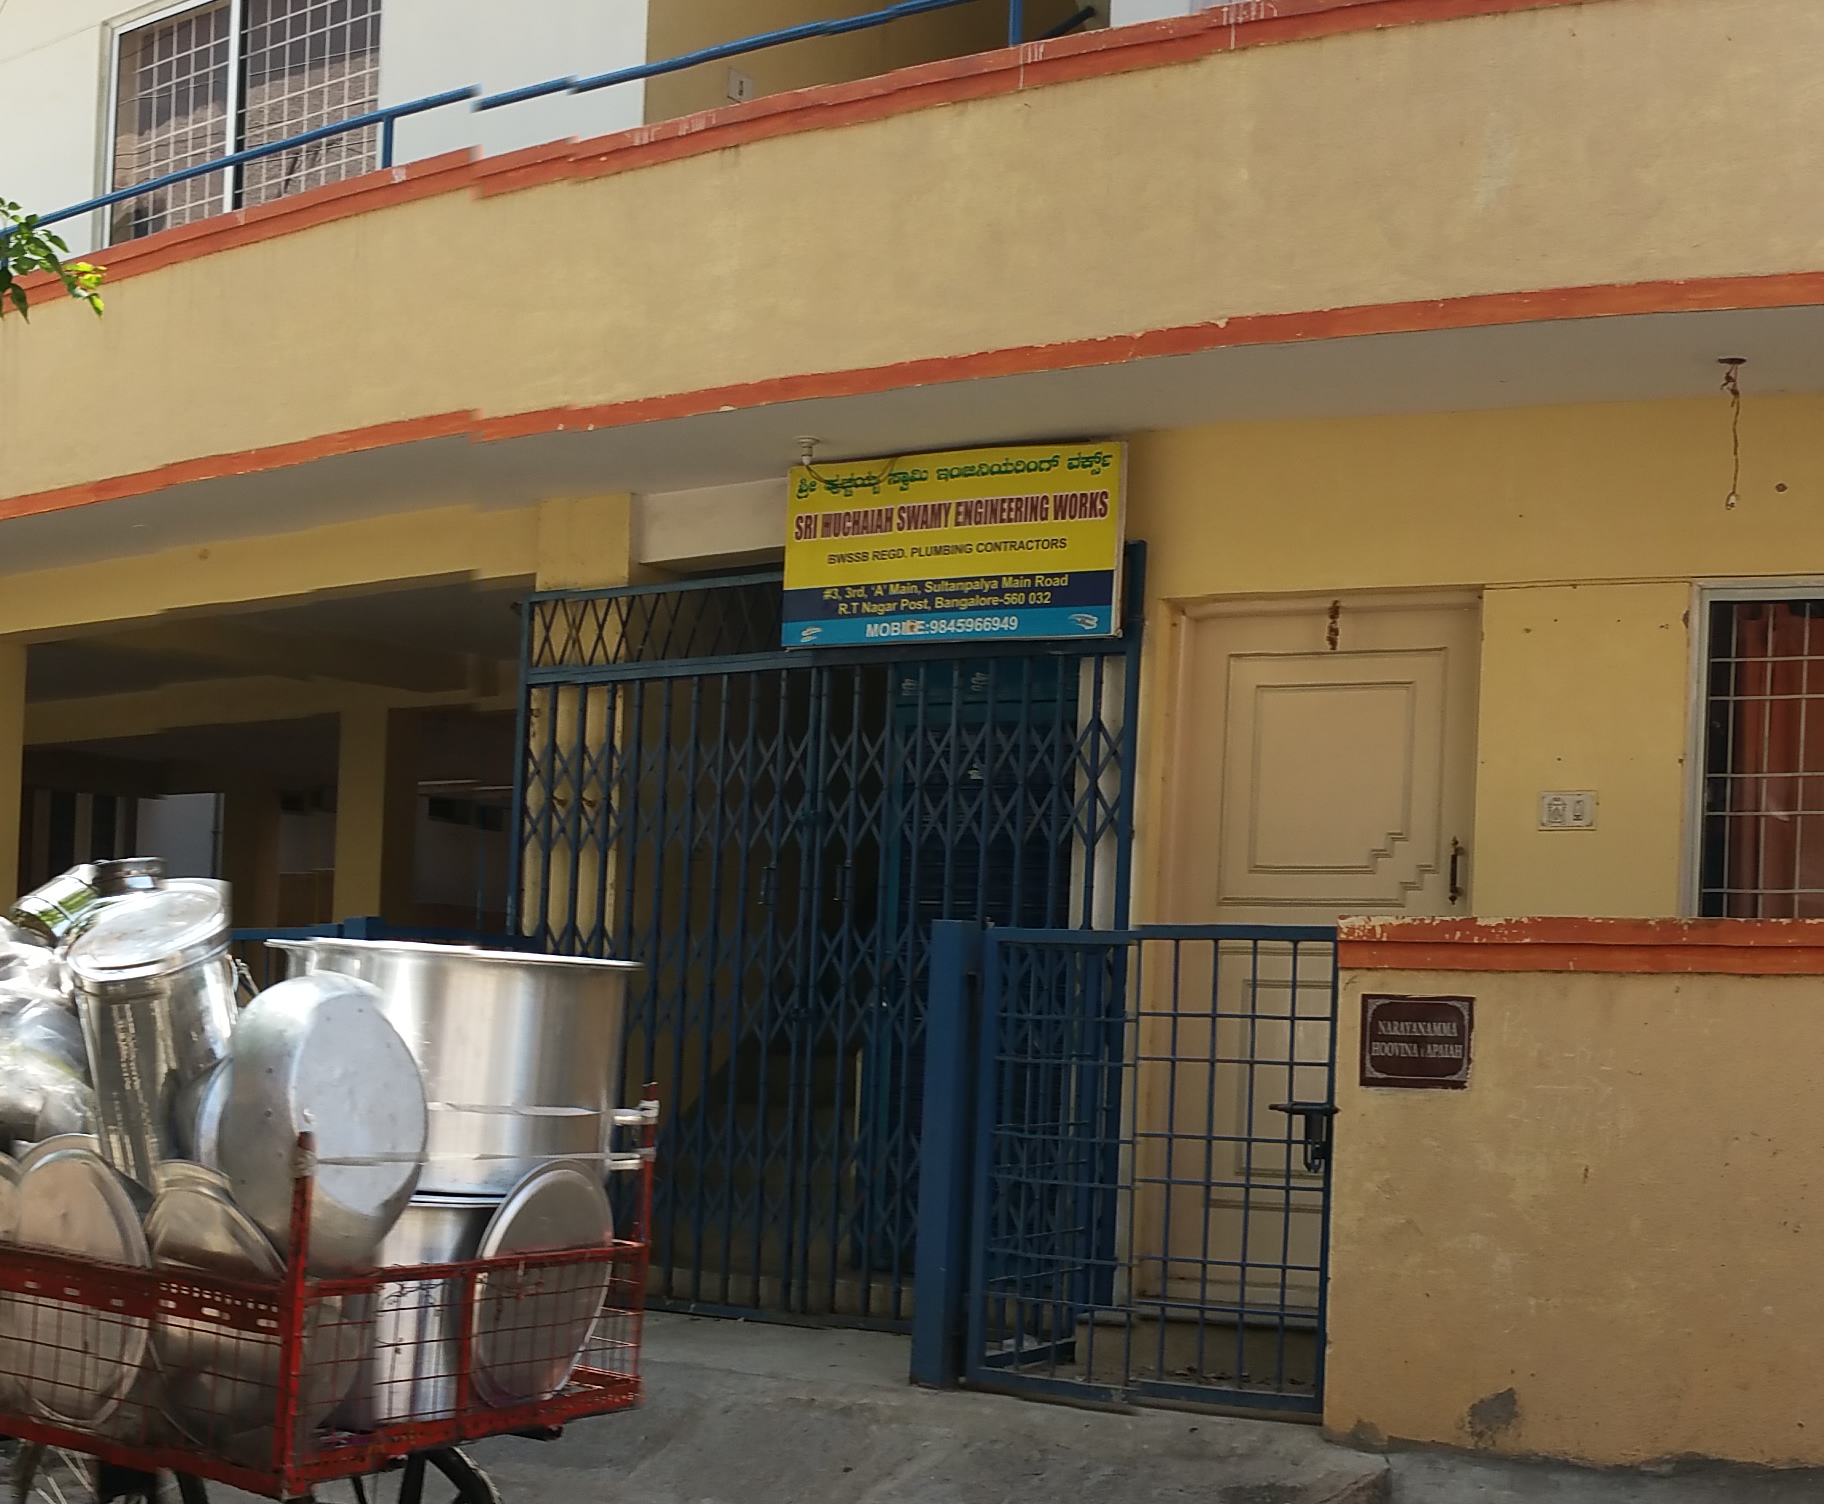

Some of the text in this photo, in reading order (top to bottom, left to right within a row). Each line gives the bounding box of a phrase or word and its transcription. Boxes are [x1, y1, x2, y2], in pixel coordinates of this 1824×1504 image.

[794, 514, 818, 541] SRI
[896, 501, 952, 531] SWAMY
[954, 494, 1049, 527] ENGINEERING
[1053, 490, 1109, 521] WORKS
[827, 538, 1067, 566] BWSSB REGD. PLUMBING CONTRACTORS
[889, 583, 921, 597] Main,
[924, 578, 998, 593] Sultanpalya
[1001, 576, 1031, 589] Main
[1035, 574, 1069, 588] Road
[861, 600, 898, 616] Nagar
[900, 598, 931, 612] Post,
[1028, 592, 1052, 605] 032
[1377, 1020, 1458, 1037] NARAYANAMMA
